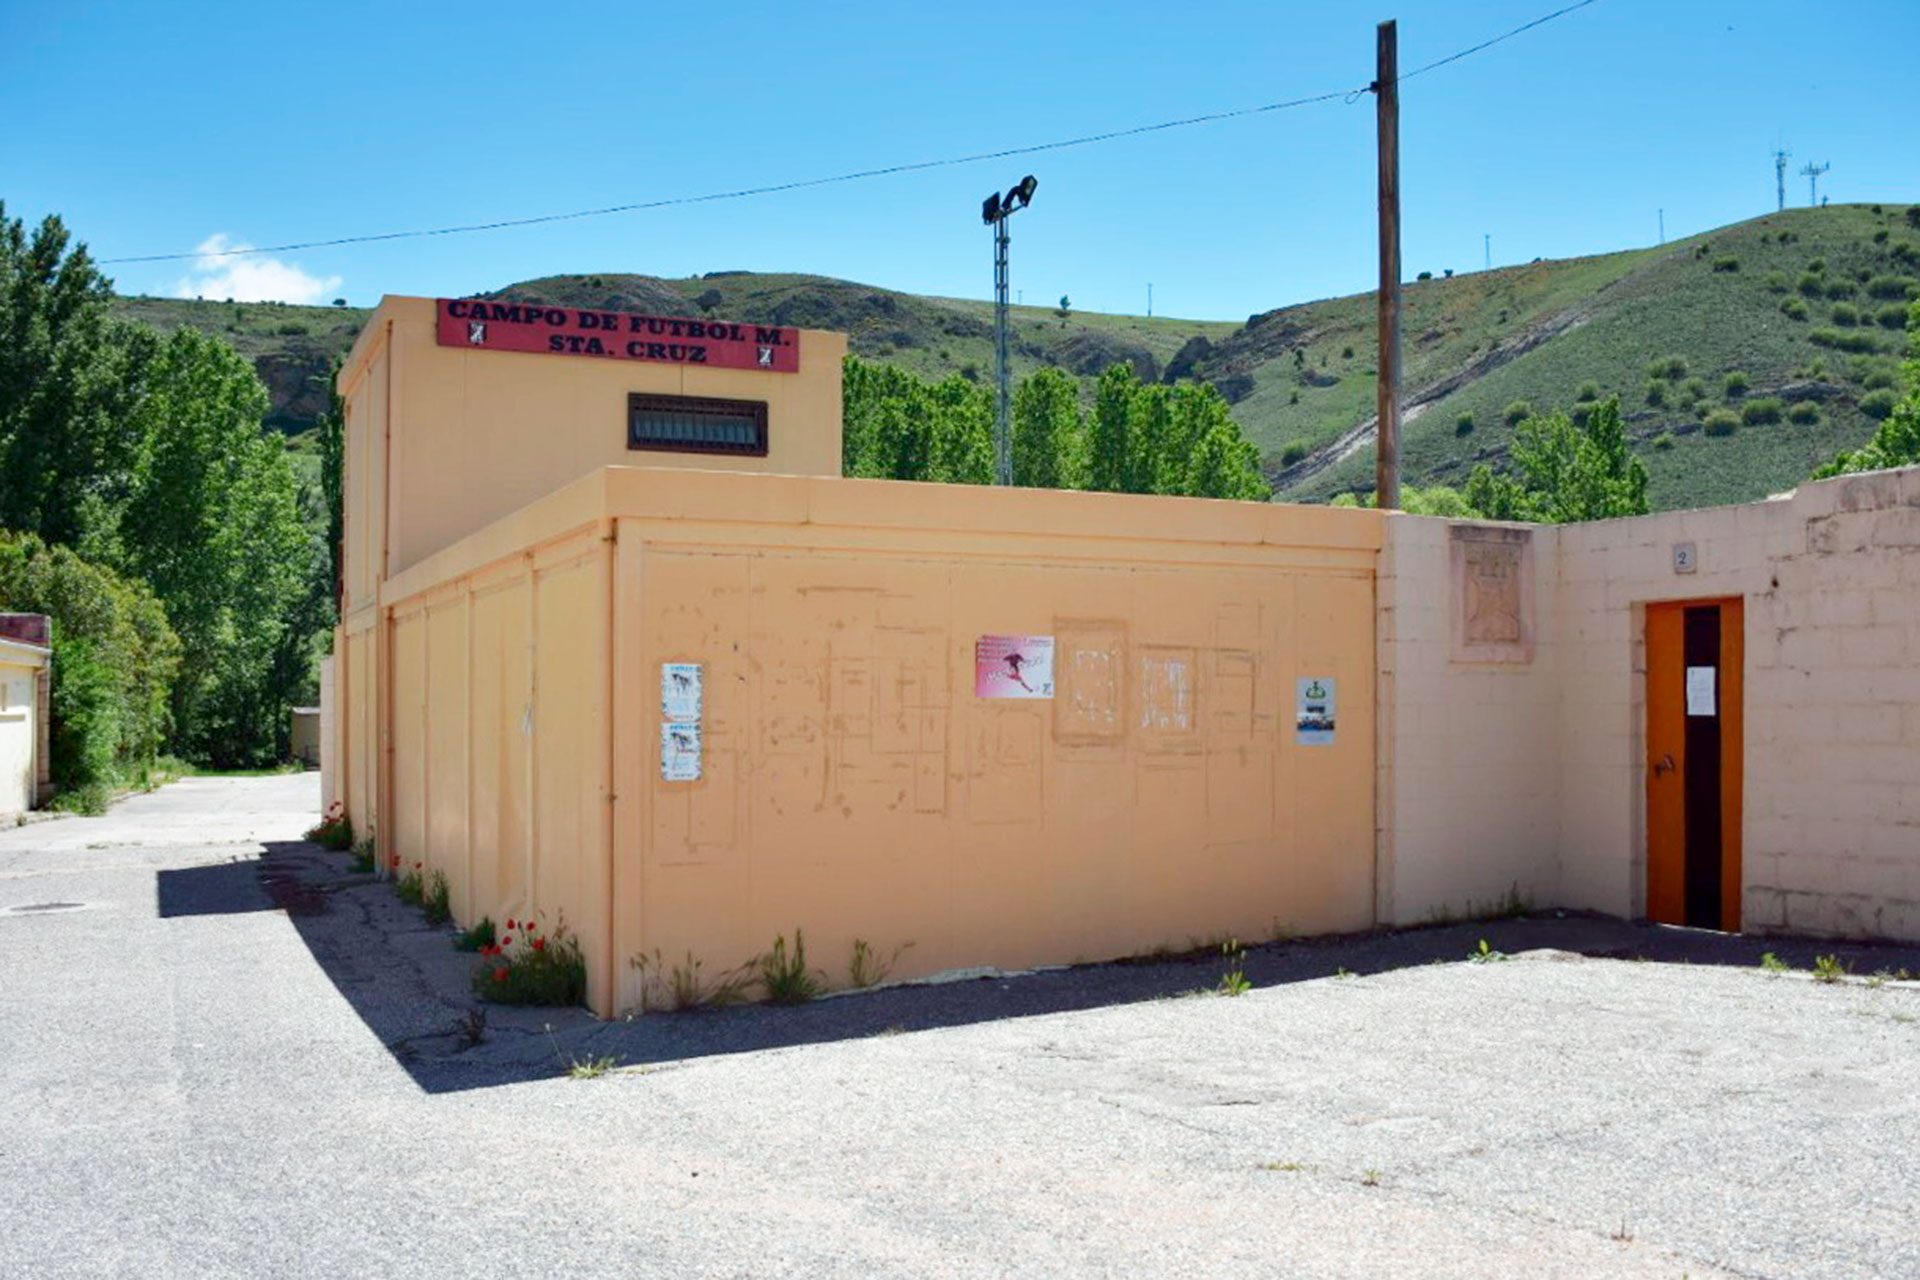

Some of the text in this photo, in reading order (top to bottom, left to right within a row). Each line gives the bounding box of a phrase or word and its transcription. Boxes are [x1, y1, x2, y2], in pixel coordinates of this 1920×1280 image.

[448, 302, 790, 346] CAMPO DE FUTBOL M.
[549, 334, 707, 363] STA. CRUZ
[1678, 551, 1687, 565] 2
